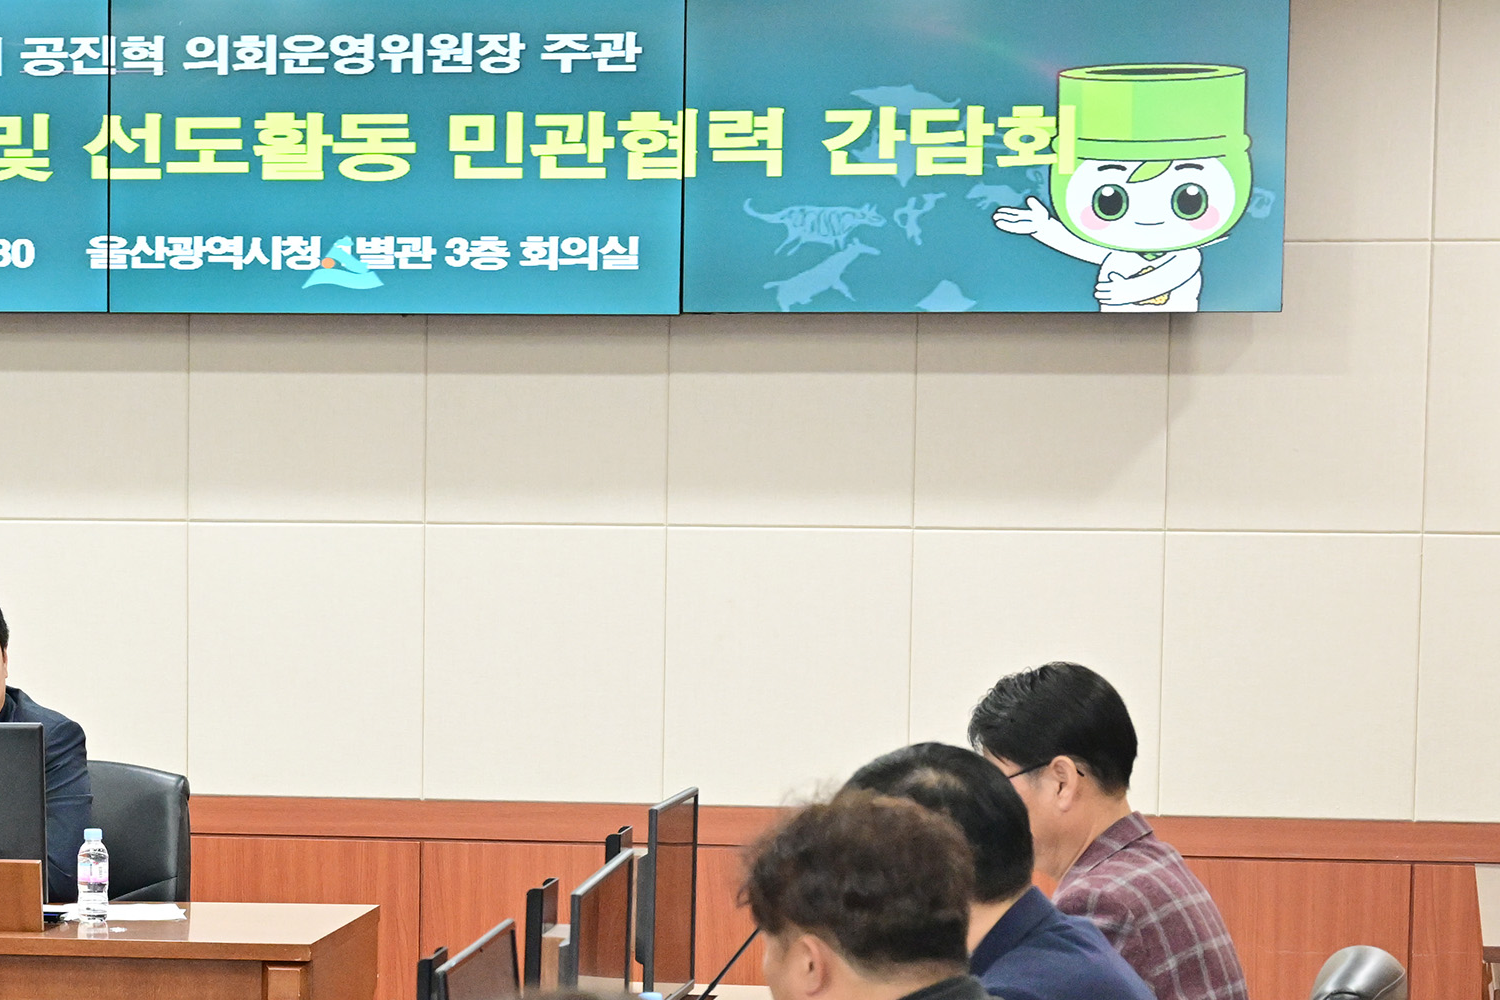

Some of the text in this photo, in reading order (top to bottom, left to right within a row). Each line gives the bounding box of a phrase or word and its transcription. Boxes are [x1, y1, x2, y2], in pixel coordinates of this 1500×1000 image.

[20, 35, 165, 77] 공진혁
[183, 32, 526, 76] 의회운영위원장
[540, 31, 643, 74] 주관
[83, 112, 417, 182] 선도활동
[449, 108, 785, 180] 민관협력
[821, 104, 1076, 177] 간담회
[85, 235, 322, 271] 울산광역시청
[336, 236, 438, 270] 별관
[445, 236, 511, 271] 3층
[519, 235, 640, 271] 회의실
